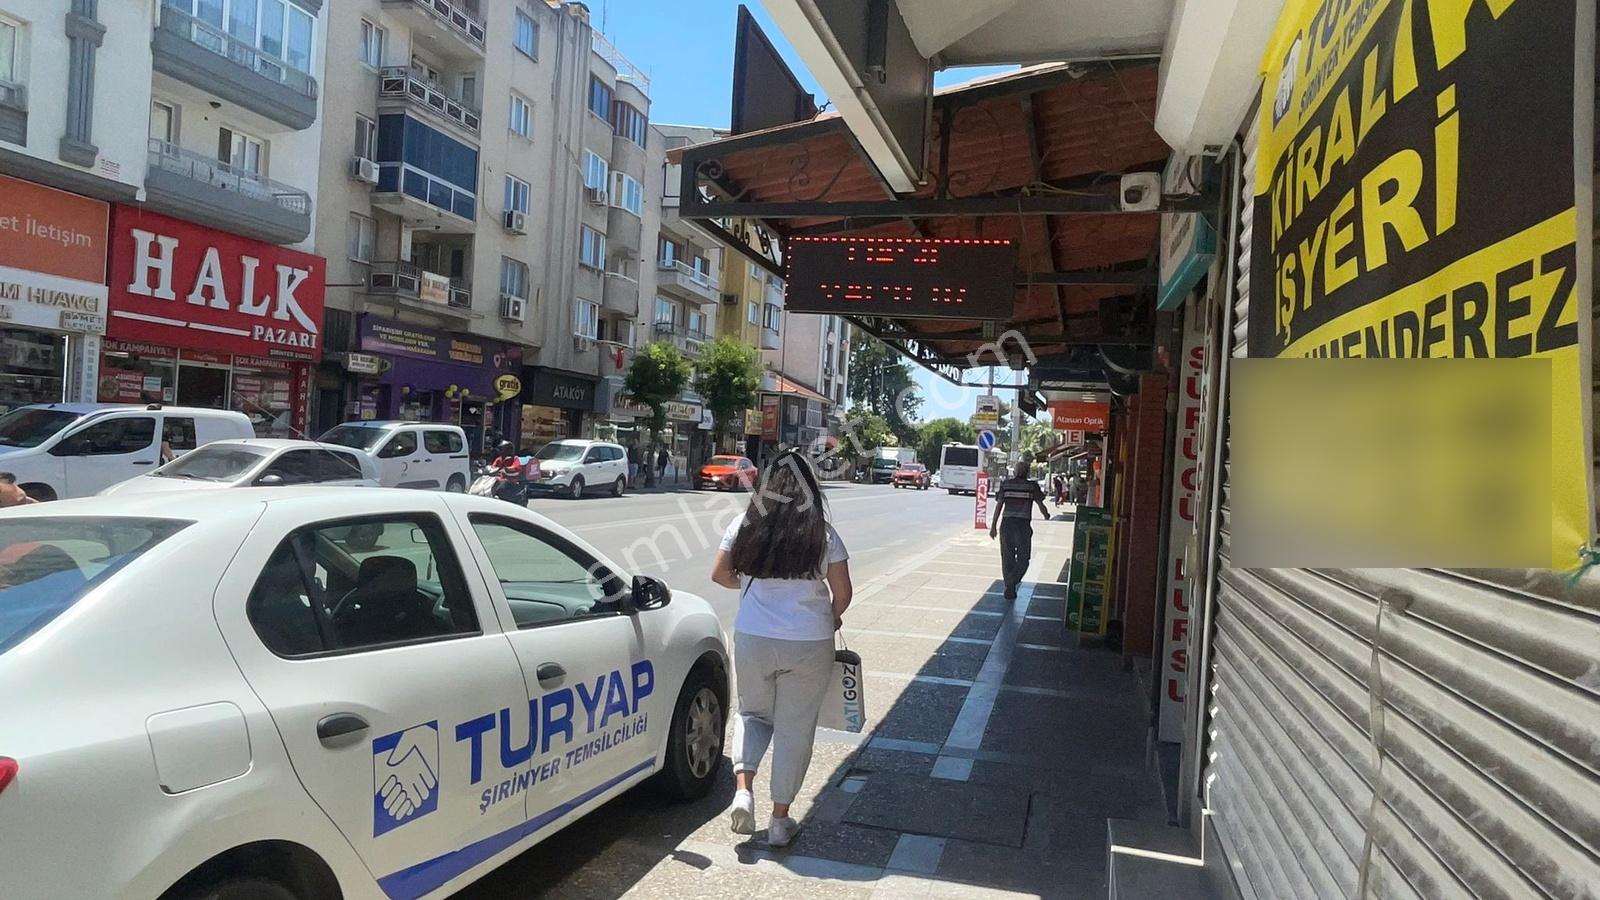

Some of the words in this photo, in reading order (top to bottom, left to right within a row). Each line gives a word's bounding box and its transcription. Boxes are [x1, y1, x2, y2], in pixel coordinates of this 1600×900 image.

[1274, 83, 1460, 346] İŞYERİ
[26, 213, 92, 247] İletişim
[0, 282, 21, 300] MI
[127, 227, 318, 334] HALK
[254, 325, 317, 350] PAZARI
[499, 378, 519, 390] gratis
[553, 384, 585, 402] ATAKÖY
[1056, 415, 1082, 424] Atasun
[1083, 416, 1104, 426] Optik
[1071, 431, 1080, 443] E
[976, 478, 988, 523] ECZANE
[455, 659, 655, 786] TURYAP
